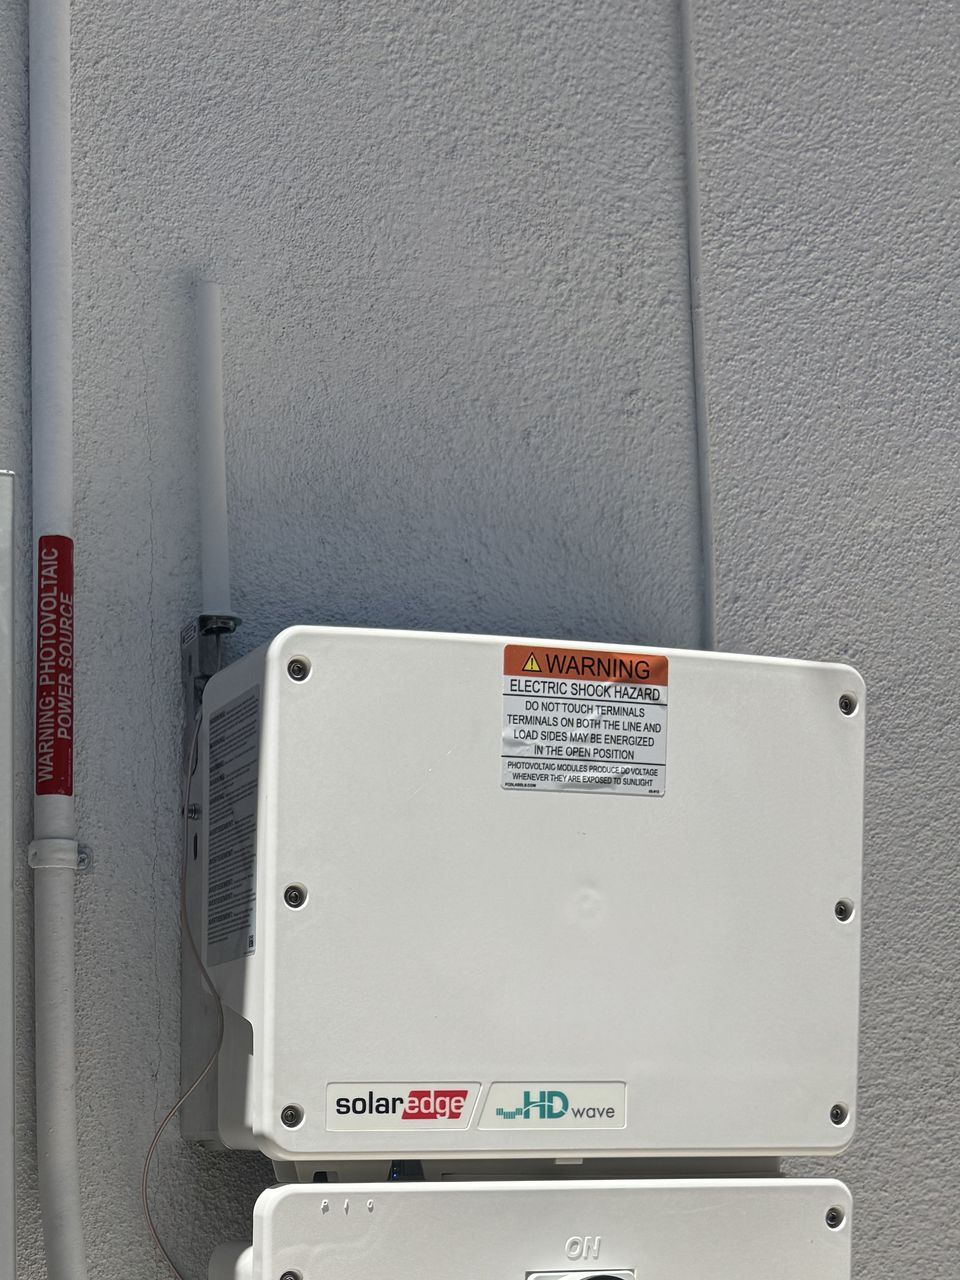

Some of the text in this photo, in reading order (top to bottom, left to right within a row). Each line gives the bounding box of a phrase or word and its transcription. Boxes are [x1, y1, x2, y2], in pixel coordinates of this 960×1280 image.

[38, 548, 57, 780] WARNING: PHOTOVOLTAIC
[57, 592, 72, 738] POWER SOURCE
[546, 654, 649, 679] WARNING
[510, 678, 660, 701] ELECTRIC SHOCK HAZARD
[525, 700, 644, 717] DO NOT TOUCH TERMINALS
[507, 714, 661, 733] TERMINALS ON BOTH THE LINE AND
[513, 729, 654, 746] LOAD SIDES MAY BE ENERGIZED
[534, 744, 634, 759] IN THE OPEN POSITION
[523, 1090, 615, 1119] HD wave
[566, 1237, 602, 1259] ON
